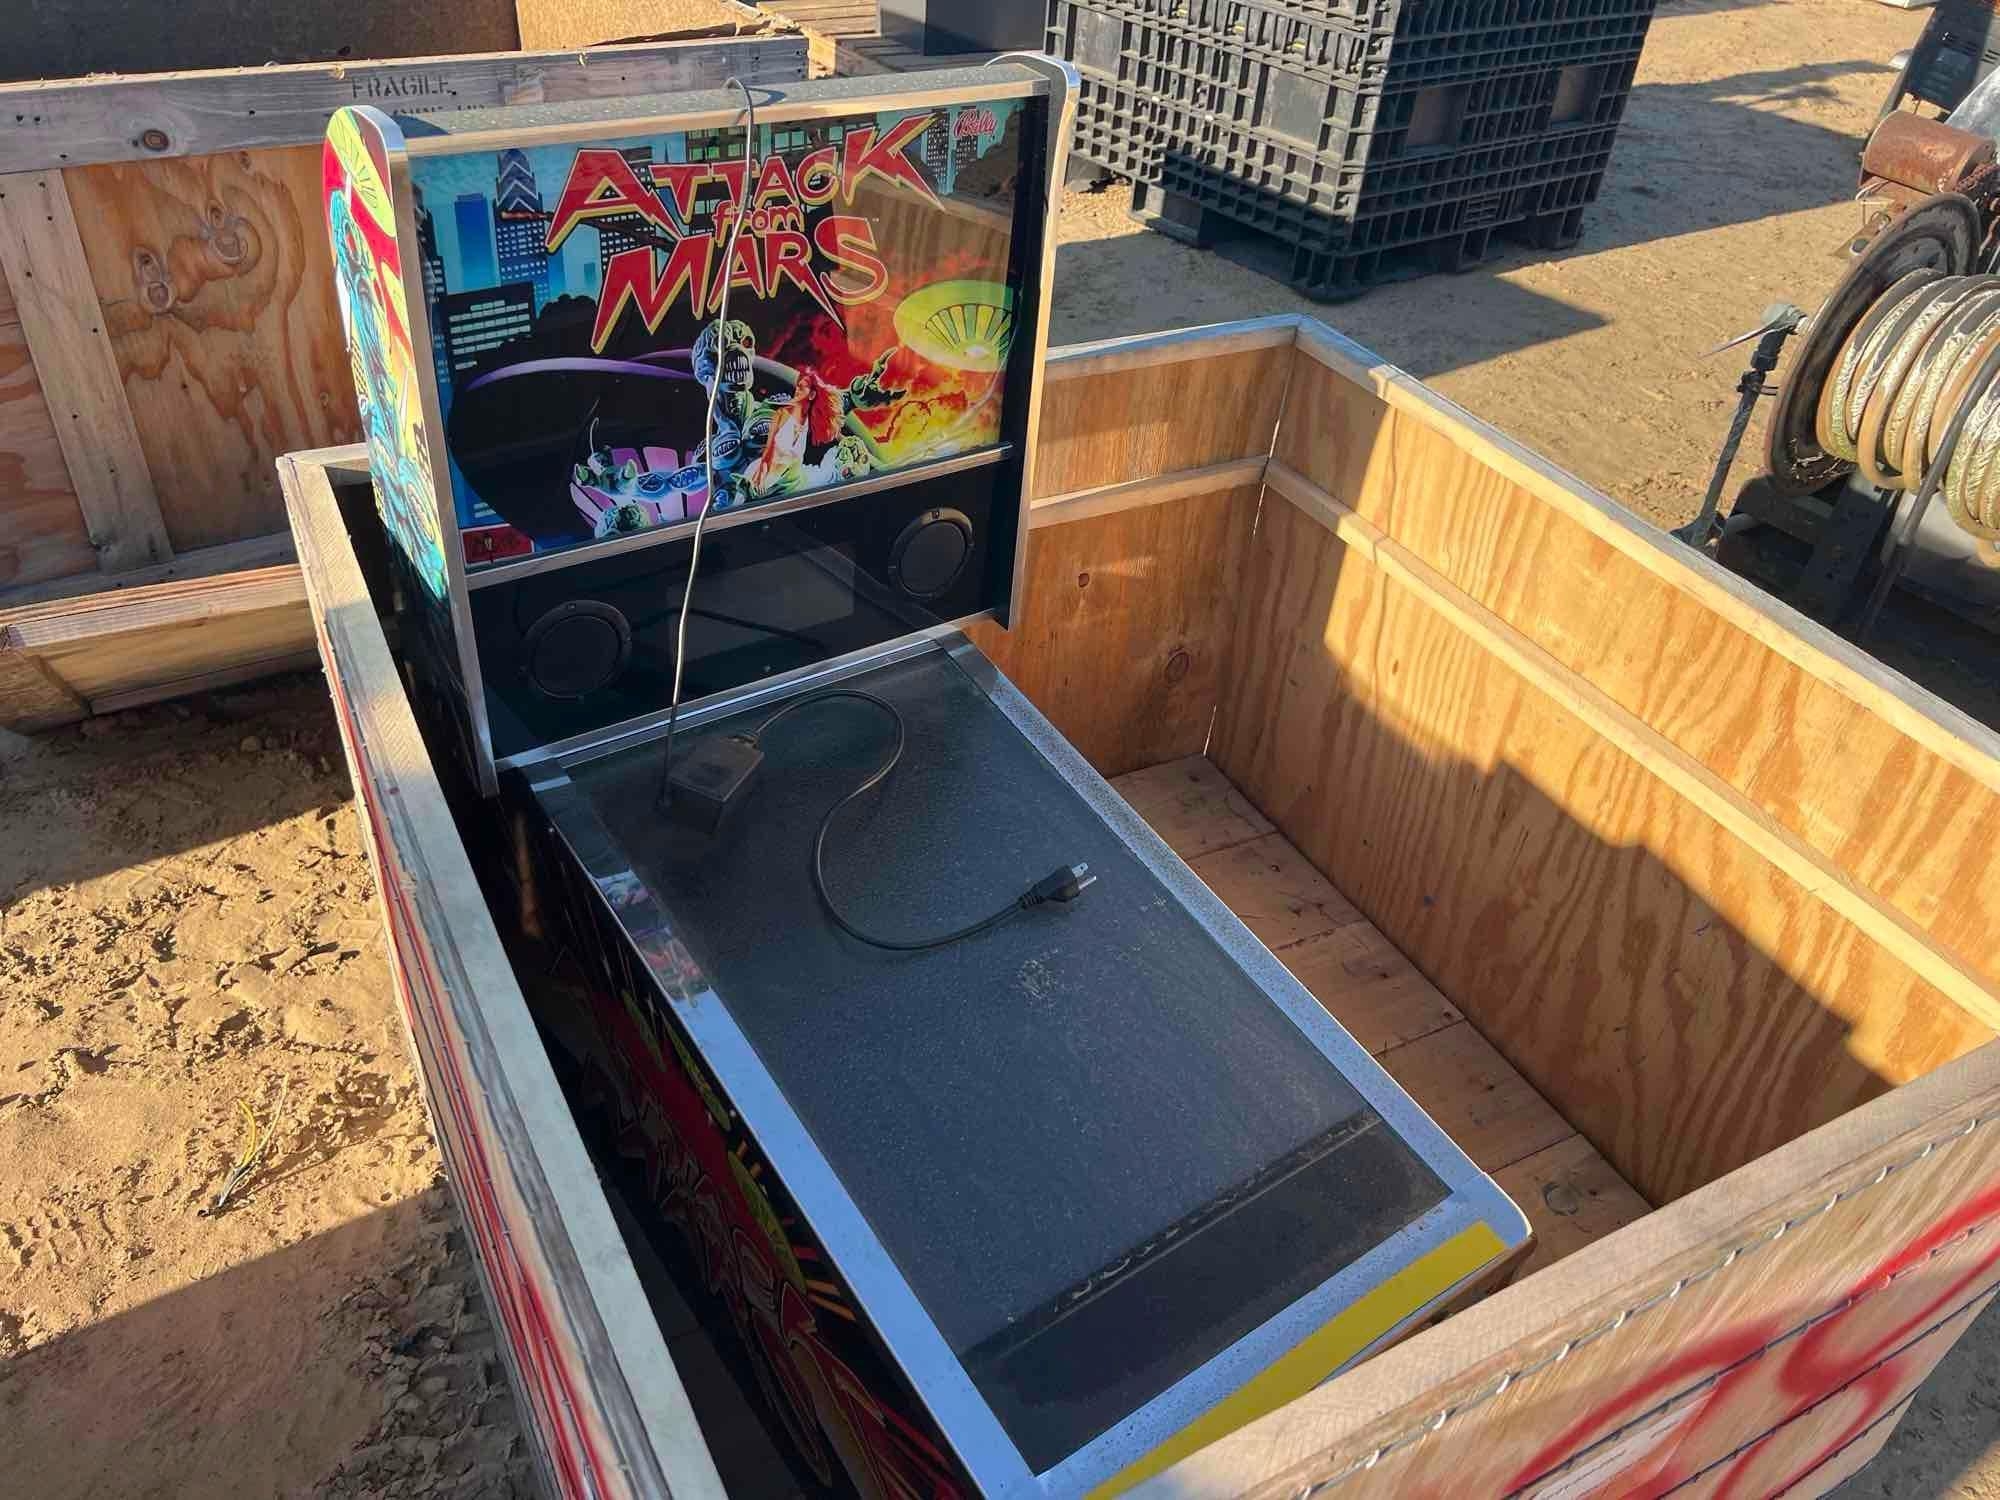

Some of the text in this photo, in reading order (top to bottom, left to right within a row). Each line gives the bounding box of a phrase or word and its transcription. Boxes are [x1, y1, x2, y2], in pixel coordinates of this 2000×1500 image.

[351, 74, 452, 99] FRAGILE
[953, 109, 997, 139] Bally
[545, 112, 946, 253] ATTACK
[712, 200, 805, 248] from
[591, 215, 888, 354] MARS
